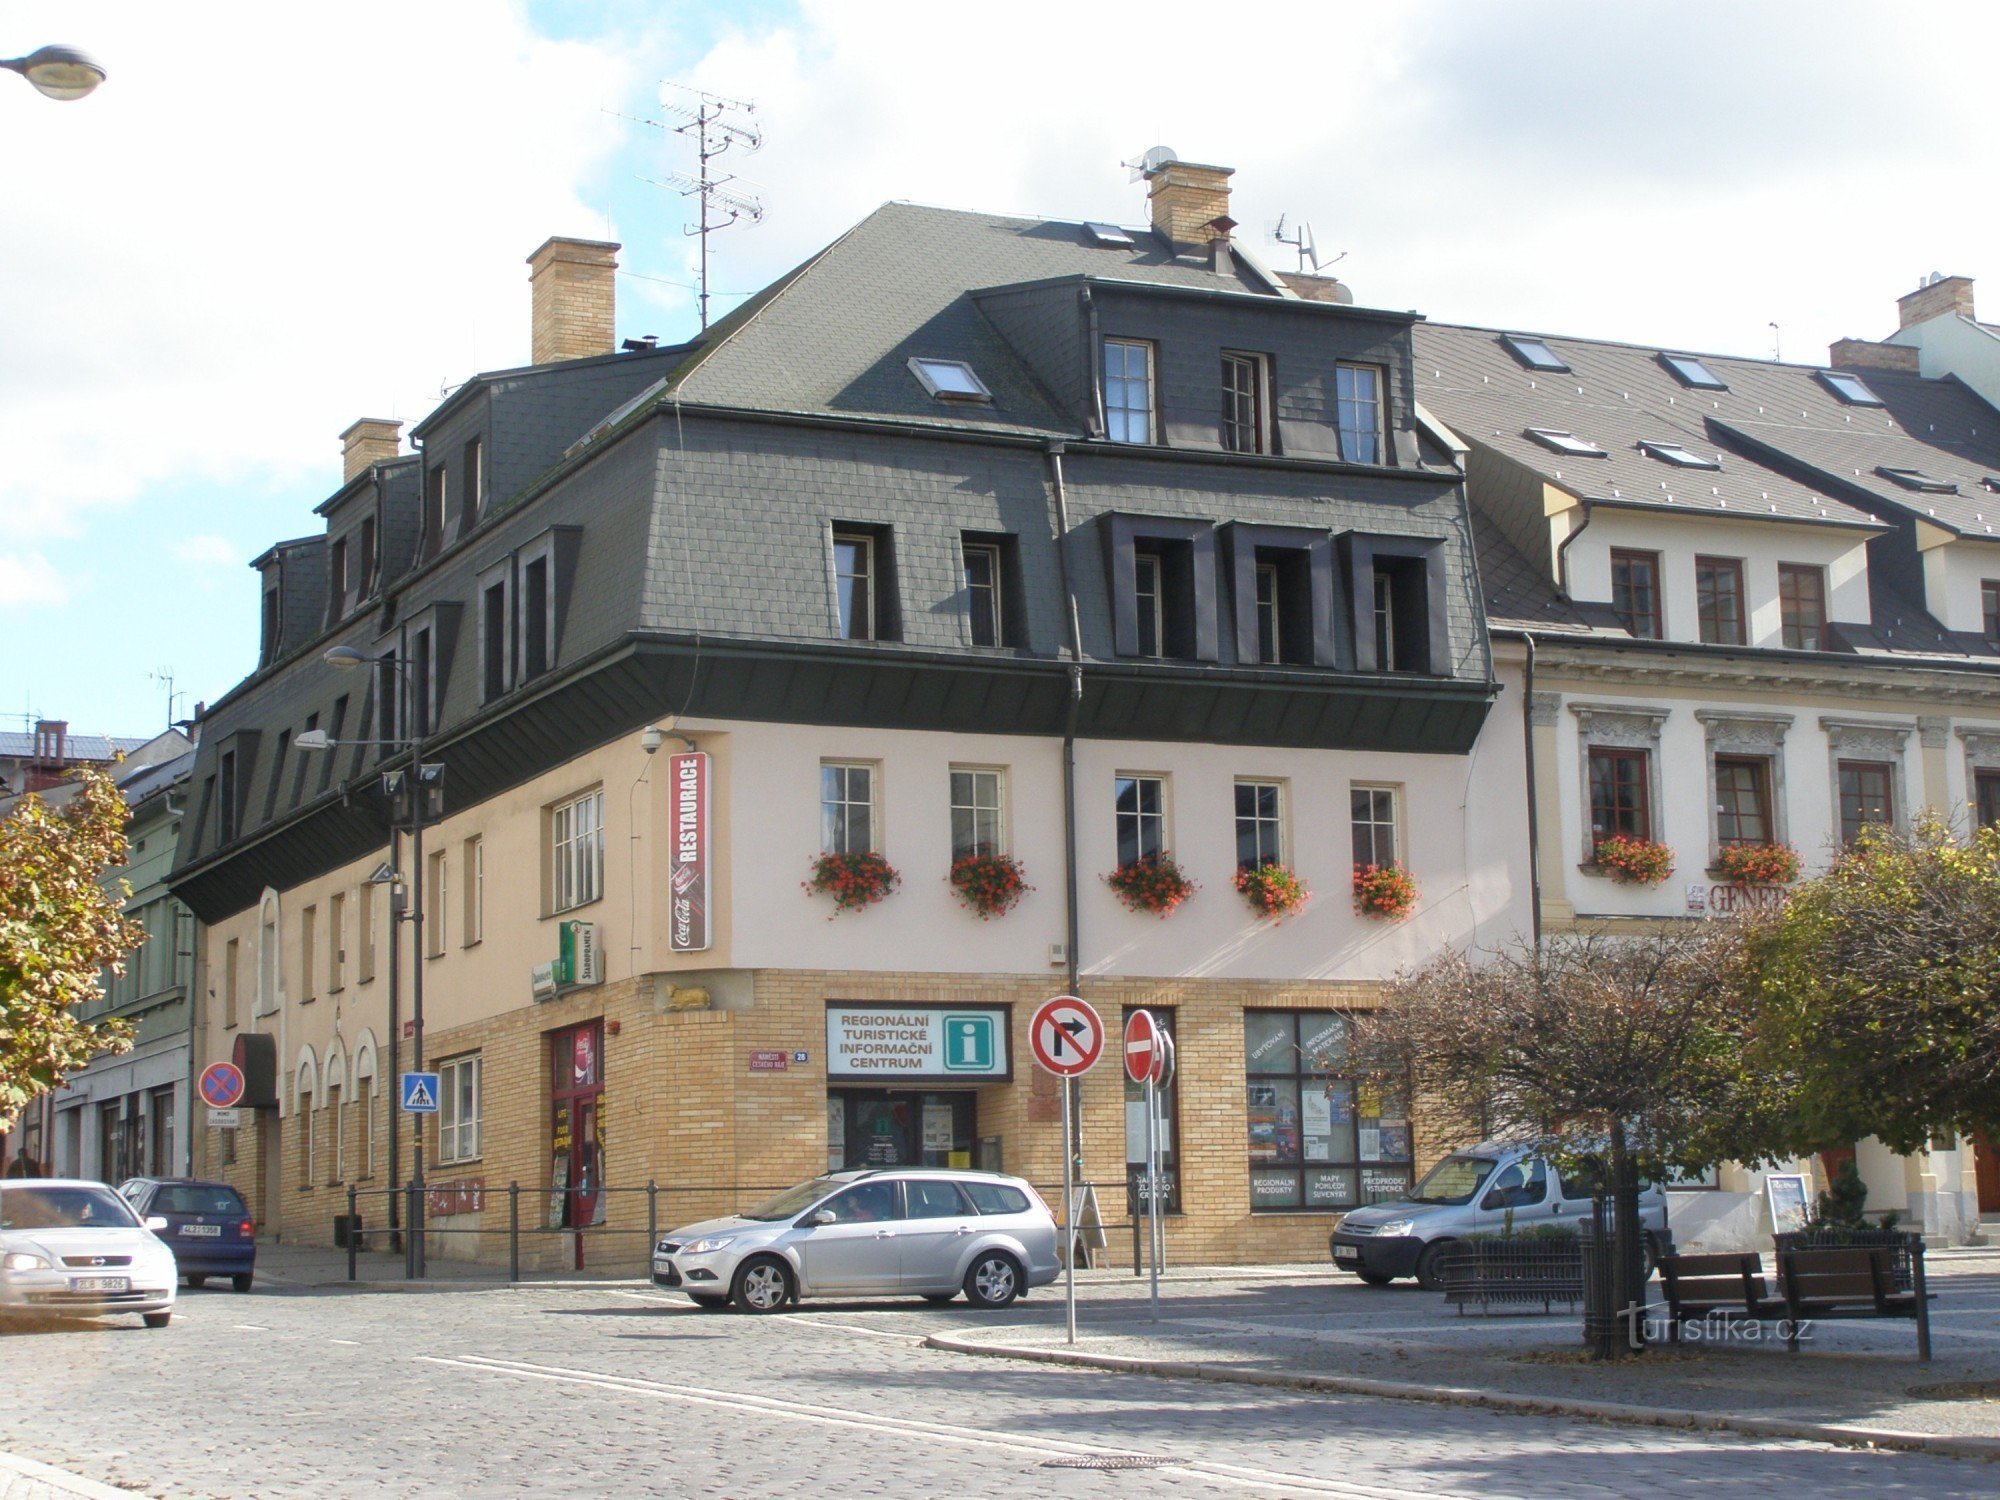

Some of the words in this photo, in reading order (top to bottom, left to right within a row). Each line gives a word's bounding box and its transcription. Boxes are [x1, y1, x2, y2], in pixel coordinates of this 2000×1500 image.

[679, 759, 697, 863] RESTAURACE
[841, 1014, 929, 1027] REGIONÁLNÍ
[844, 1028, 927, 1041] TURISTICKÉ
[839, 1043, 932, 1055] INFORMAČNÍ
[850, 1057, 922, 1069] CENTRUM
[1256, 1186, 1293, 1195] PRODUKTY
